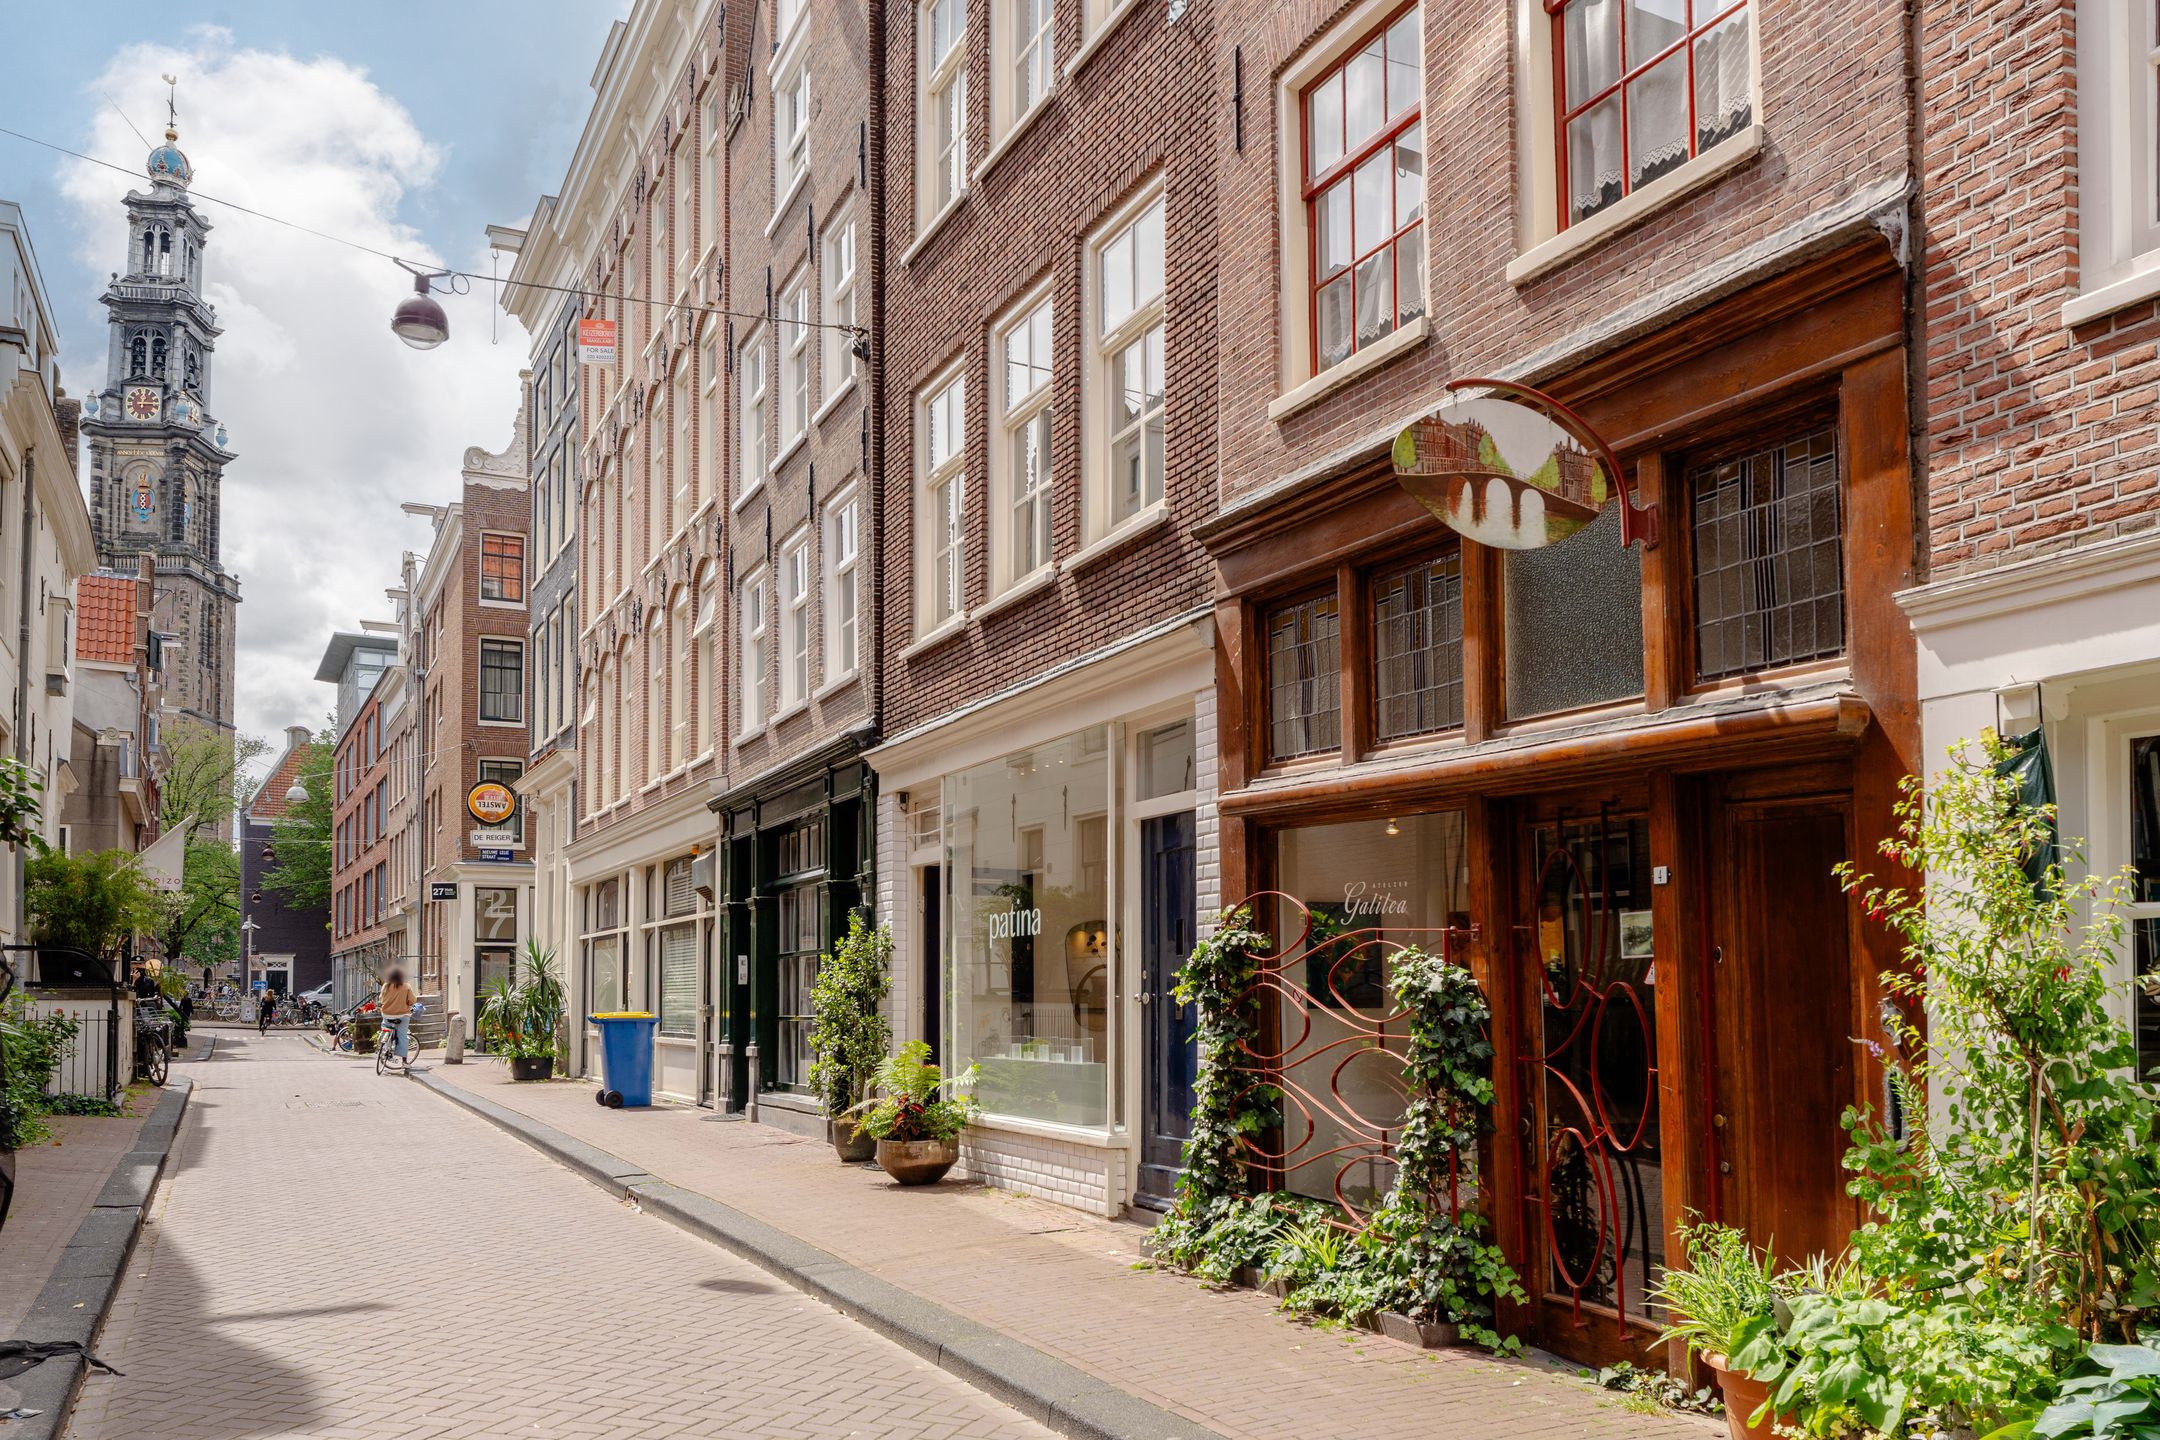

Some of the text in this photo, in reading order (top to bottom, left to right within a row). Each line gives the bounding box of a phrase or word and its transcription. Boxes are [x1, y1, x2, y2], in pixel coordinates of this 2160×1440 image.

[478, 801, 507, 810] AMSTEL
[1372, 881, 1408, 889] ATELIER
[433, 888, 445, 896] 27
[1340, 881, 1409, 926] Galilea
[989, 898, 1041, 949] patina
